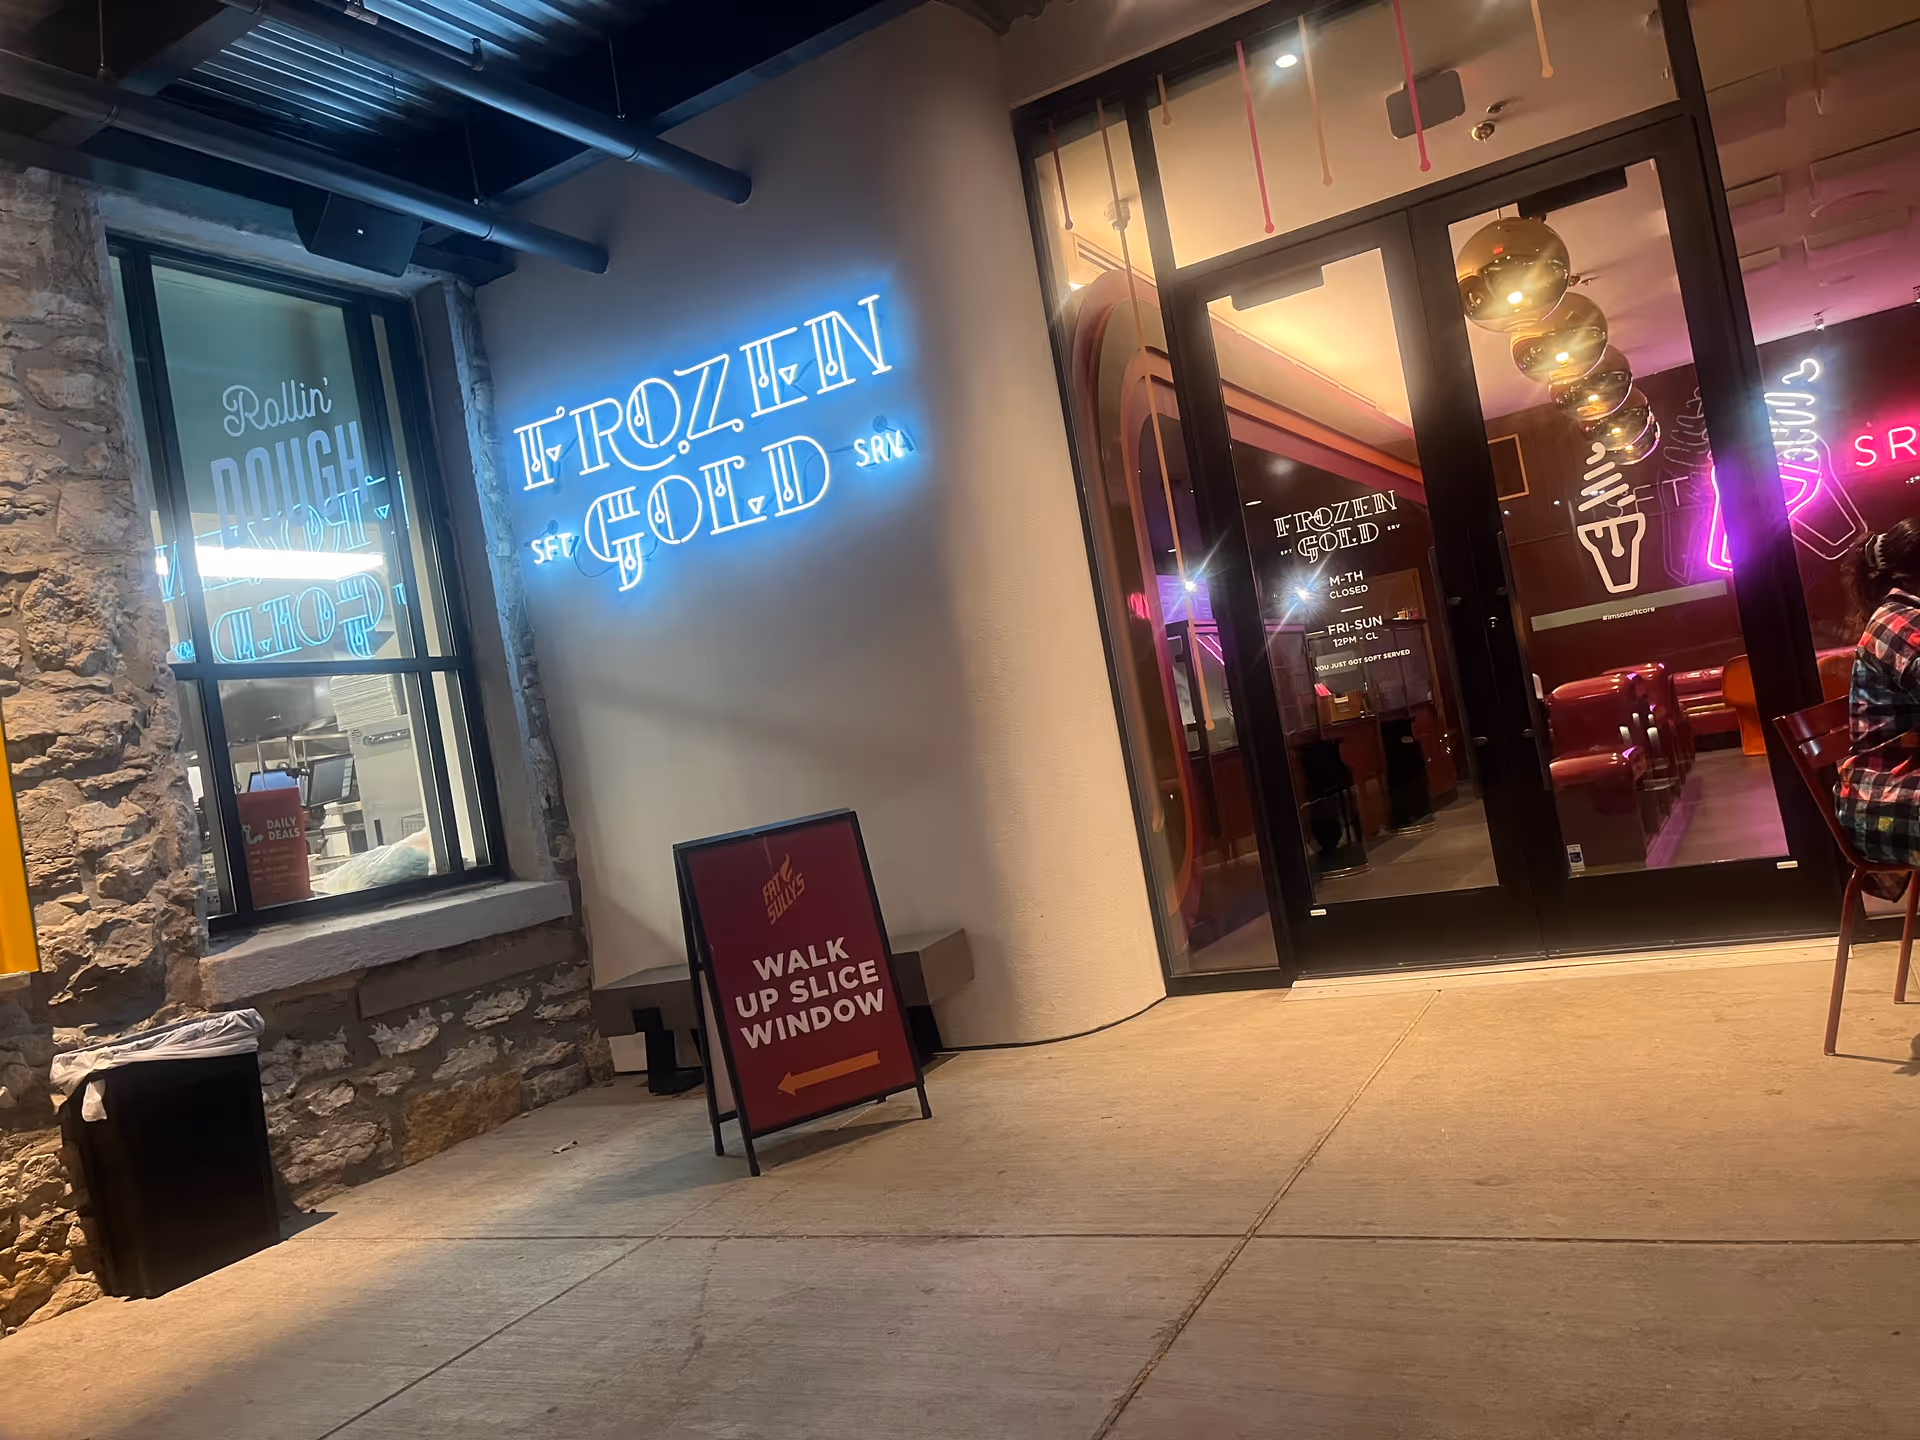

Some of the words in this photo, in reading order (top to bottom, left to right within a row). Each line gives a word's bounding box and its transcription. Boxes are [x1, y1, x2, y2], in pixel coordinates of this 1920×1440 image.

[221, 376, 333, 437] Rollin'
[513, 294, 893, 491] FROZEN
[210, 420, 370, 550] DOUGH
[531, 532, 572, 565] SFT
[583, 434, 830, 592] GOLD
[853, 429, 904, 467] SRV
[1273, 489, 1398, 538] FROZEN
[1297, 522, 1380, 564] GOLD
[1329, 570, 1364, 587] M-TH
[1329, 584, 1369, 599] CLOSED
[1327, 615, 1383, 636] FRI-SUN
[1602, 606, 1656, 621] #imsosoftcore
[1333, 635, 1357, 648] 12PM
[1365, 631, 1379, 641] CL
[1314, 664, 1329, 672] YOU
[1330, 660, 1347, 669] JUST
[1348, 657, 1363, 666] GOT
[1363, 654, 1382, 663] SOFT
[1383, 648, 1411, 659] SERVED
[266, 816, 297, 830] DAILY
[268, 827, 301, 841] DEALS
[762, 872, 781, 906] FAT
[752, 936, 850, 981] WALK
[734, 987, 780, 1019] UP
[788, 959, 880, 1004] SLICE
[740, 988, 885, 1049] WINDOW
